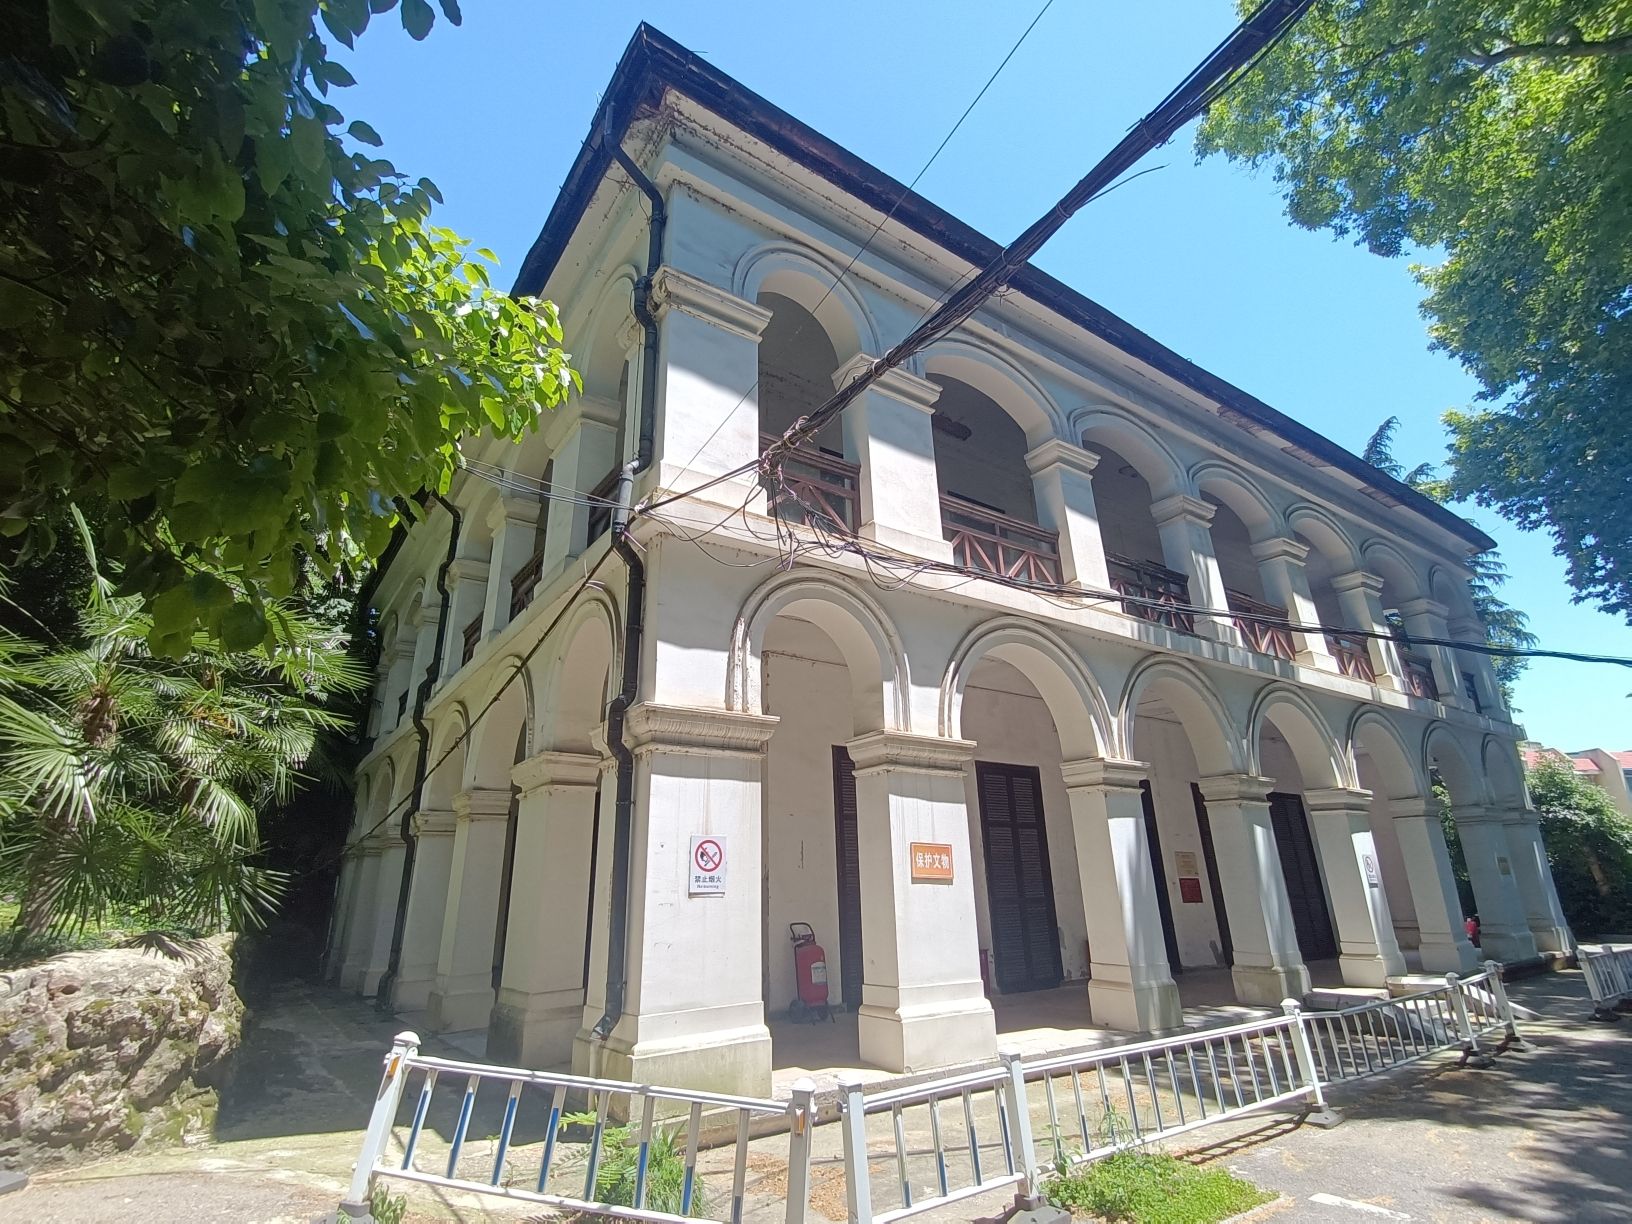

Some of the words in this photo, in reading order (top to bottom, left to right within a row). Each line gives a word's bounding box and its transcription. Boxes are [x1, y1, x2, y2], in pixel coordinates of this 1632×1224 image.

[916, 852, 950, 870] 保护文物
[694, 875, 722, 883] 禁止烟火
